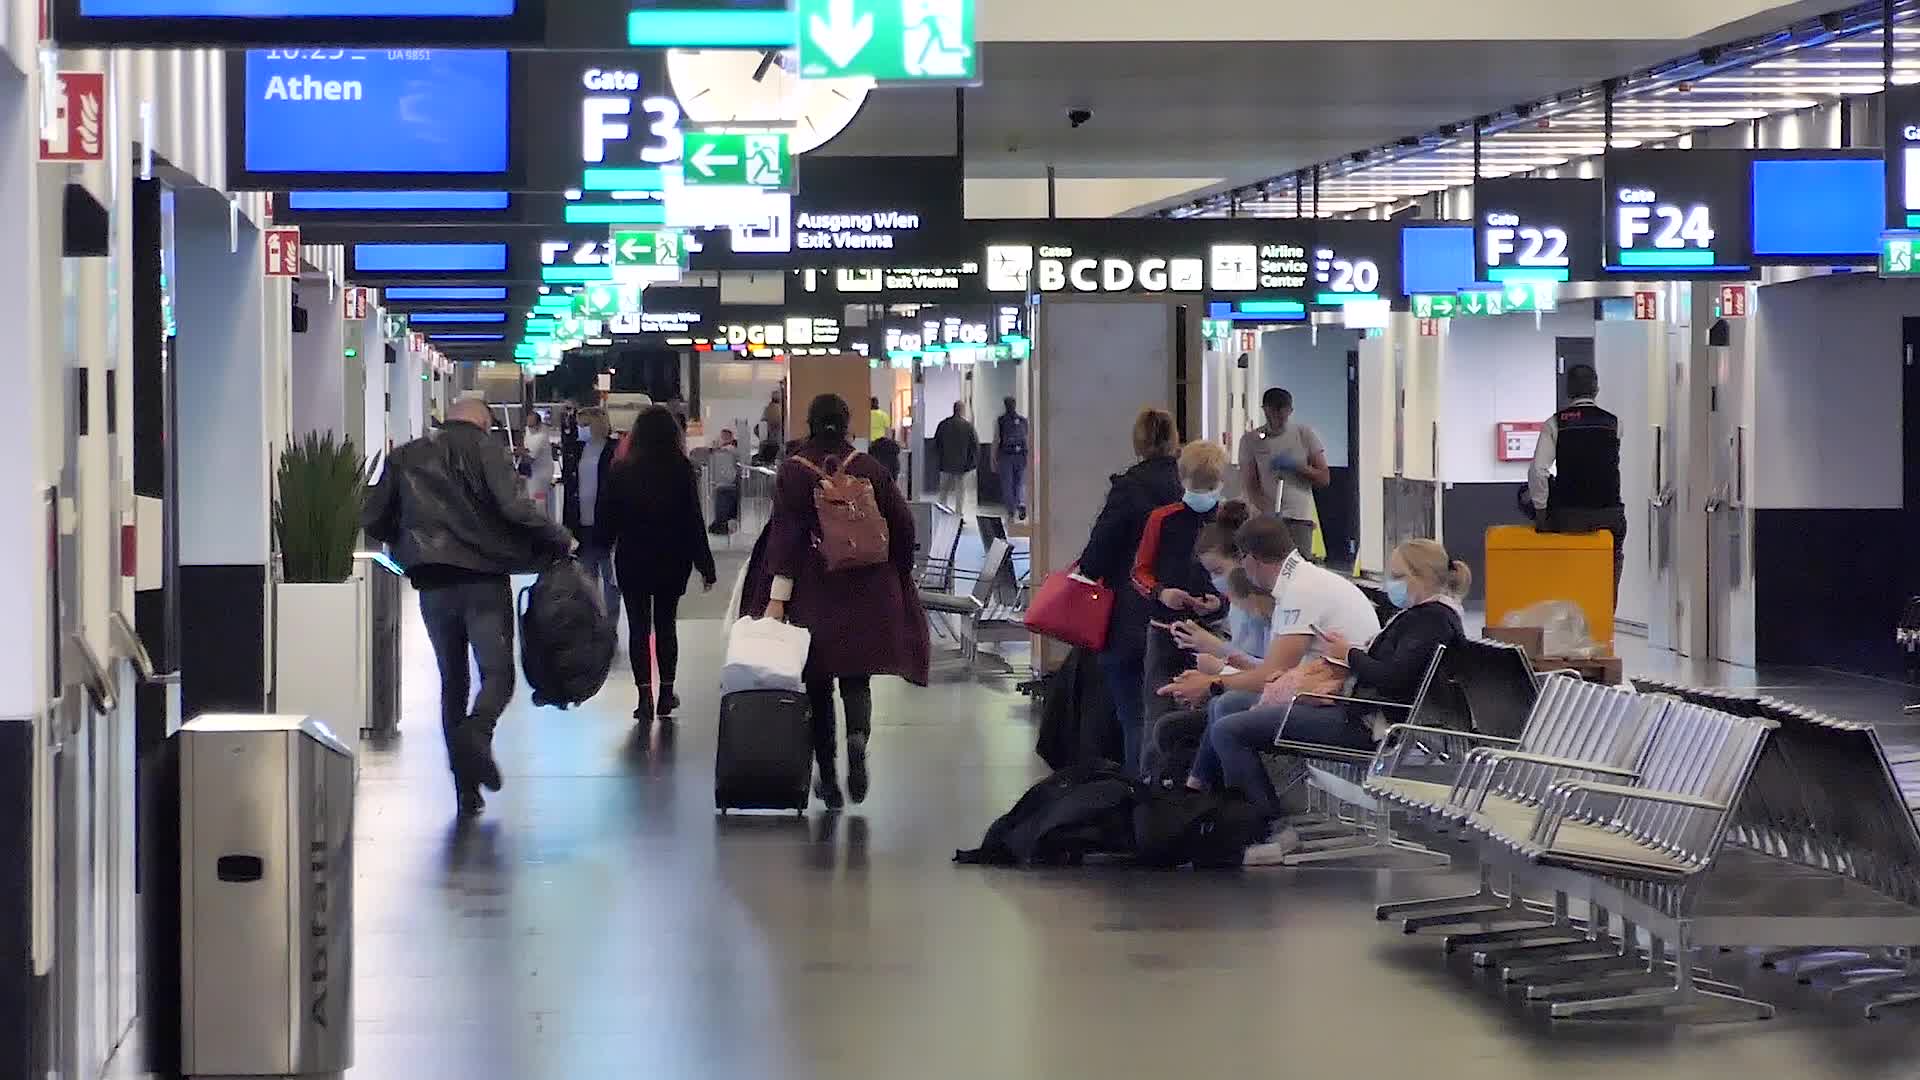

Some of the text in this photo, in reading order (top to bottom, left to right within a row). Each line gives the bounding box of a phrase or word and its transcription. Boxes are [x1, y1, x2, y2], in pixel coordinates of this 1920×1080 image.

[584, 69, 640, 90] Gate
[264, 75, 363, 101] Athen
[1619, 188, 1656, 203] Gate
[797, 212, 919, 232] Ausgang Wien
[1488, 213, 1520, 226] Gate
[797, 232, 893, 249] Exit Vienna
[1039, 246, 1072, 257] Gates
[1260, 245, 1304, 258] Airline
[1261, 260, 1308, 273] Service
[1260, 275, 1305, 288] Center
[1283, 608, 1301, 625] 77
